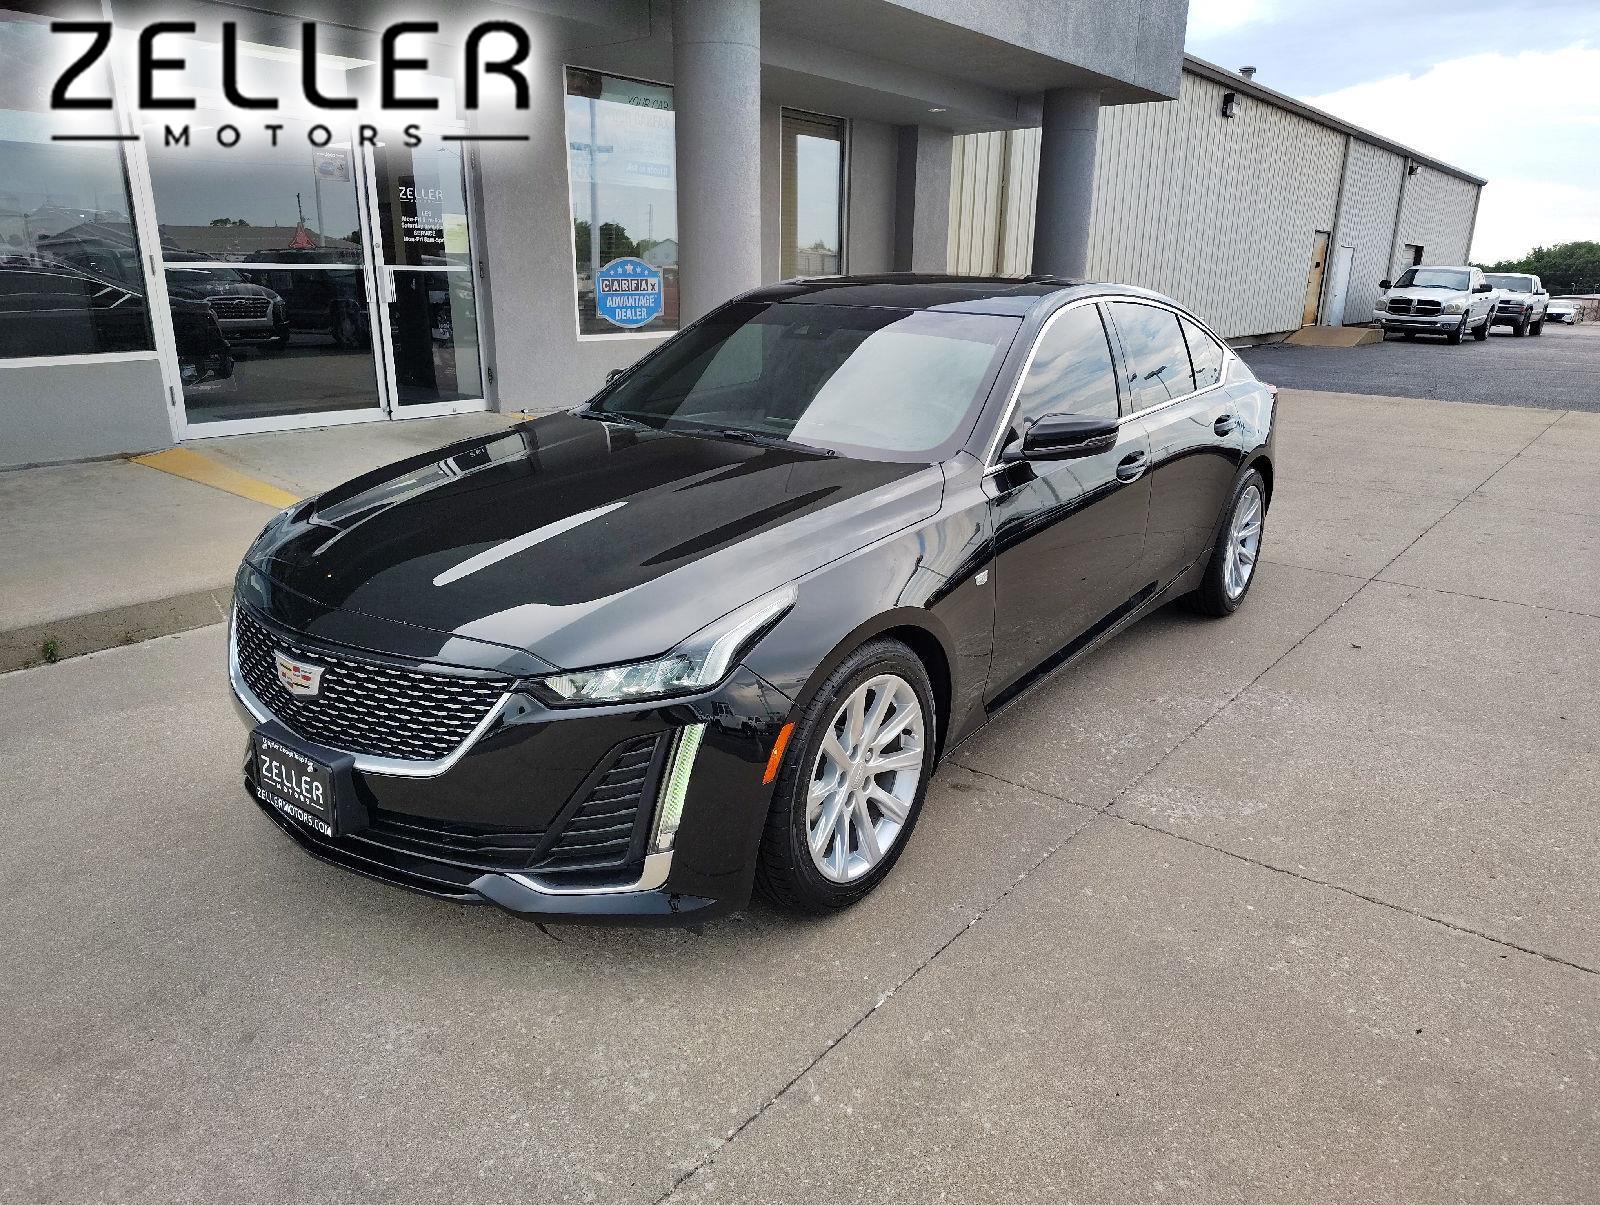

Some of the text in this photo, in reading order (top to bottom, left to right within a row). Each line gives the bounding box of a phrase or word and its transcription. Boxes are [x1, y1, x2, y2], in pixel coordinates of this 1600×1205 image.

[627, 96, 669, 110] YOUR CAR
[398, 186, 443, 201] ZELLER
[602, 279, 657, 292] CARFAX
[606, 294, 655, 308] ADVANTAGE
[615, 308, 647, 320] DEALER
[260, 754, 324, 805] ZELLER
